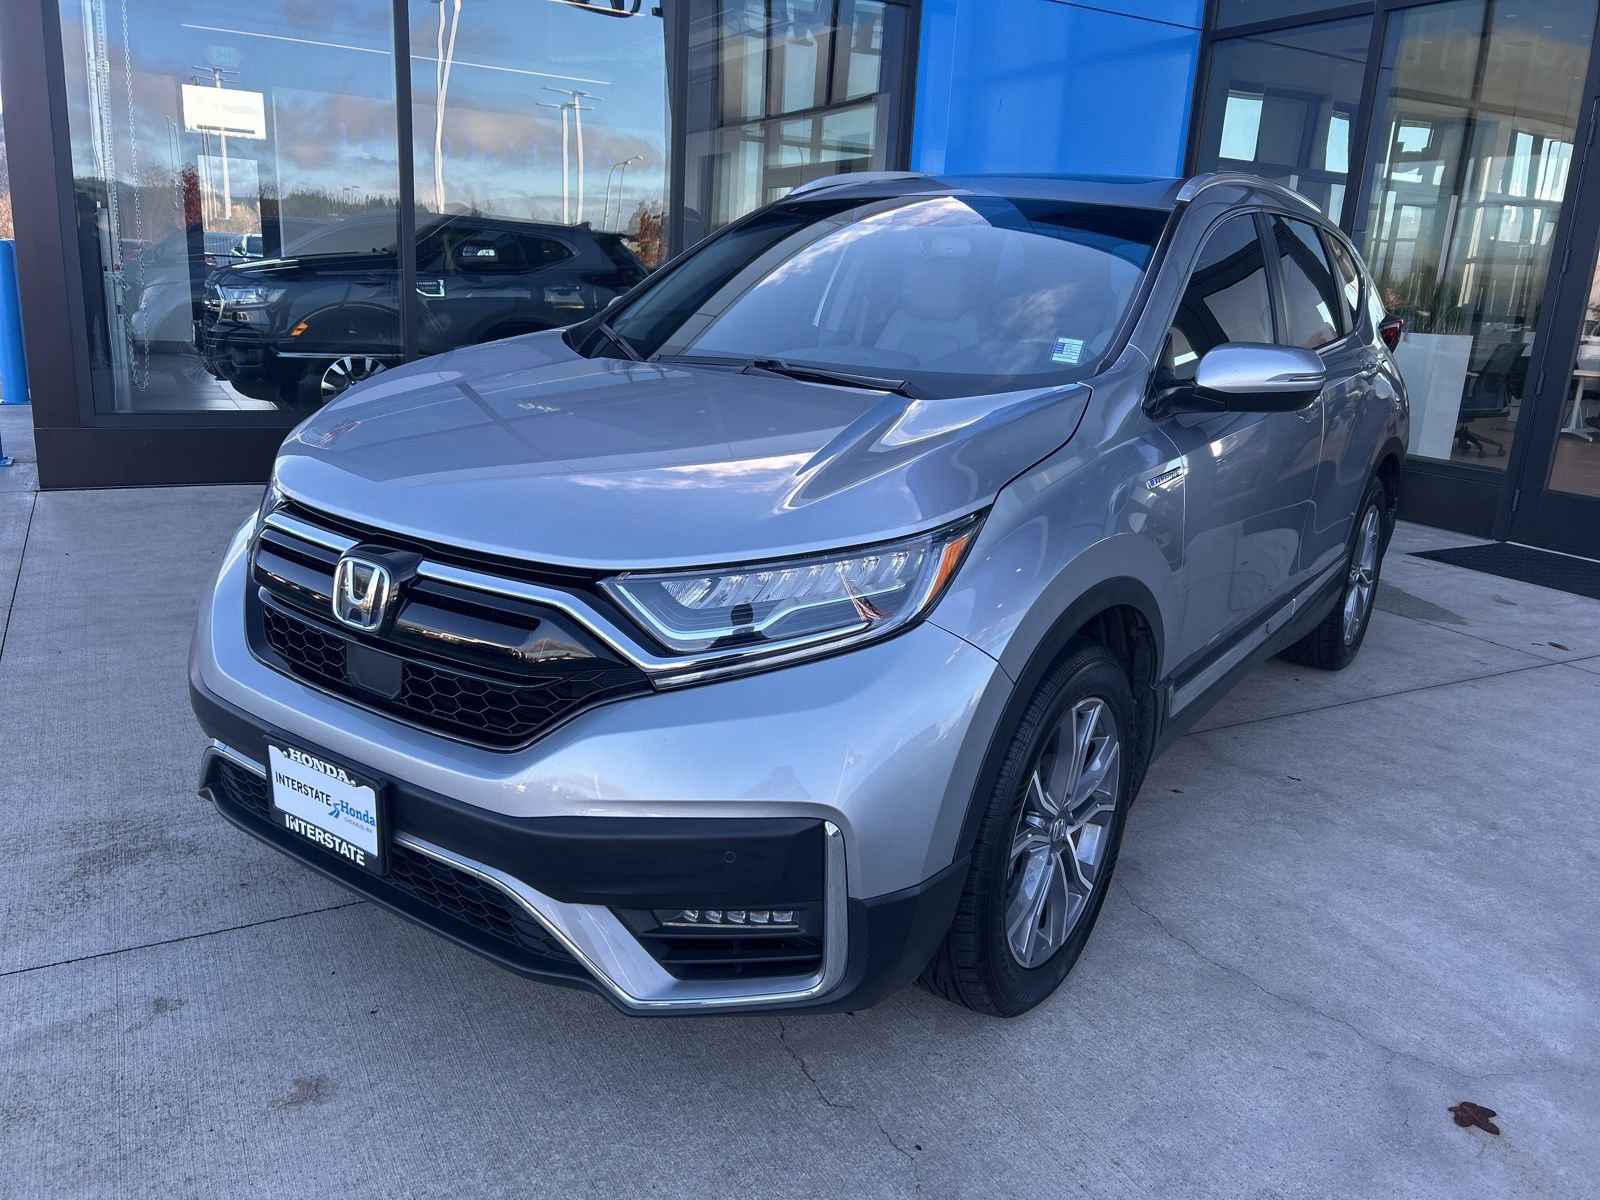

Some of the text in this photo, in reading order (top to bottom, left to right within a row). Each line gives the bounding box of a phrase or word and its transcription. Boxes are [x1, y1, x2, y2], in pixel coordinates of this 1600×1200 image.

[287, 747, 350, 783] HONDA
[275, 771, 332, 807] INTERSTATE
[340, 800, 376, 827] Honda
[285, 813, 366, 867] INTERSTATE
